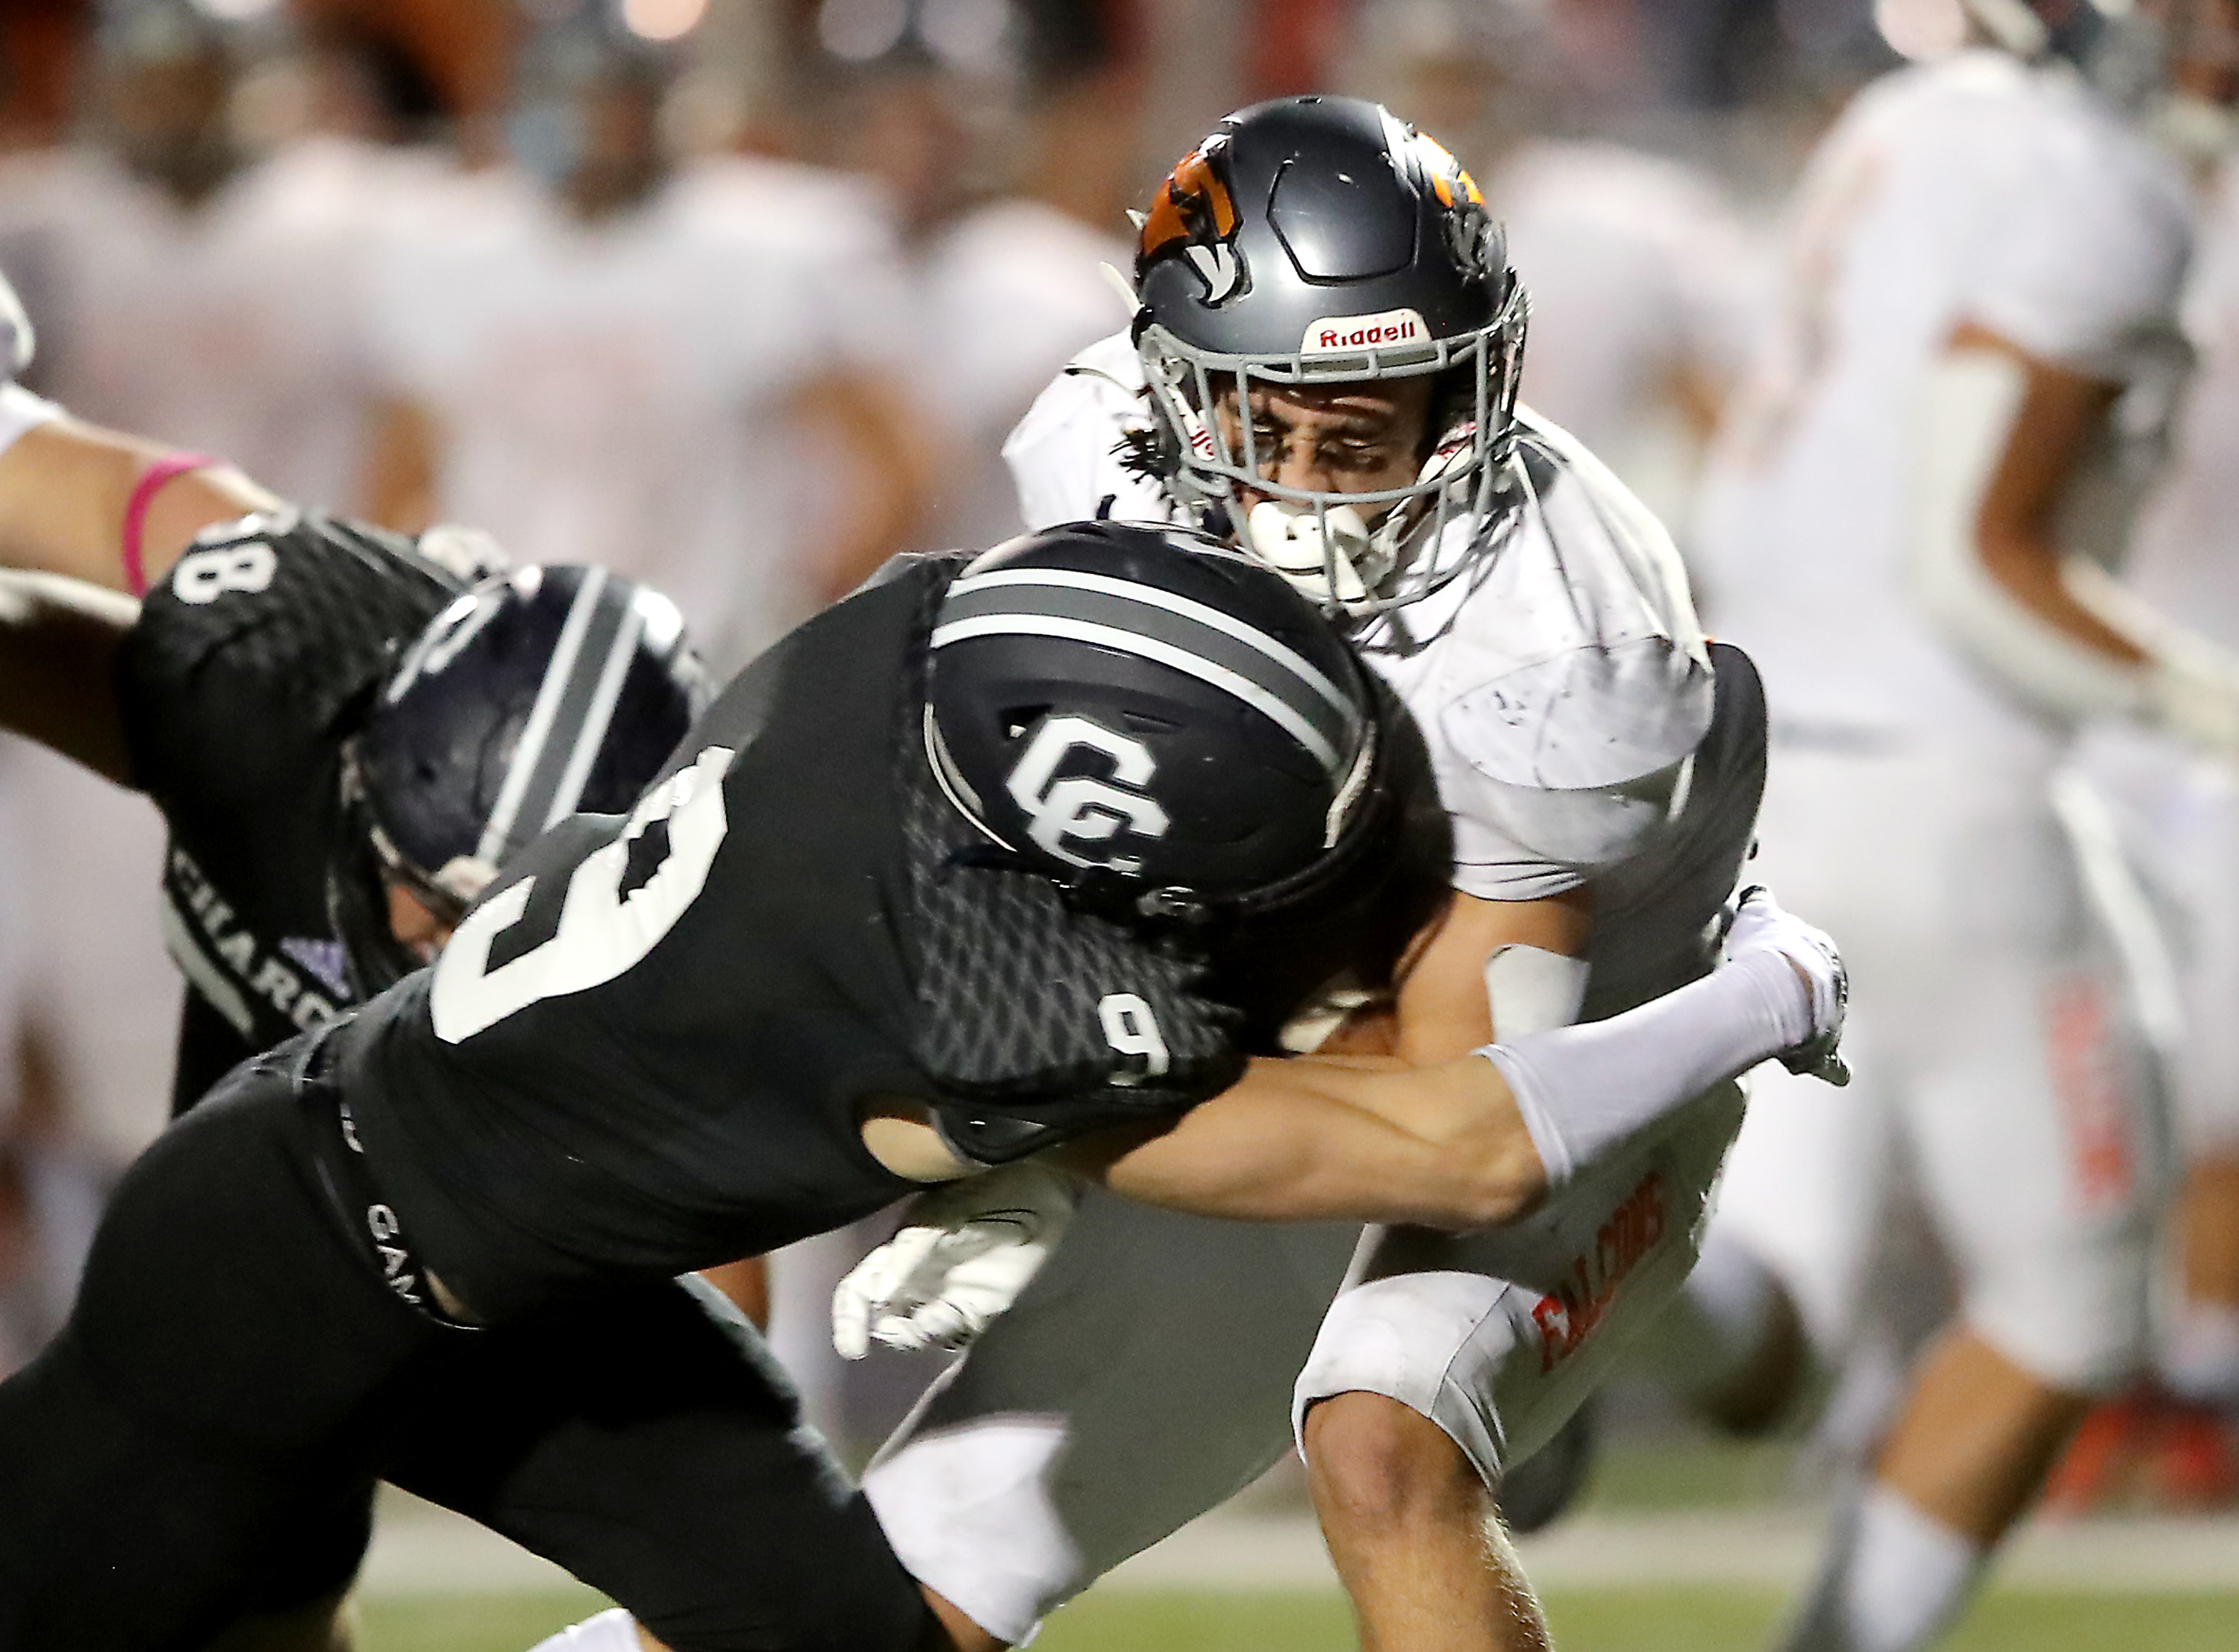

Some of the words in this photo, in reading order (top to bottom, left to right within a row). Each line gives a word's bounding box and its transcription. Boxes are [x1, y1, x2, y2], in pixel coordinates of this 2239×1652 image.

[1320, 322, 1415, 348] Riddell
[428, 745, 736, 1045] 9
[1097, 992, 1170, 1086] 9
